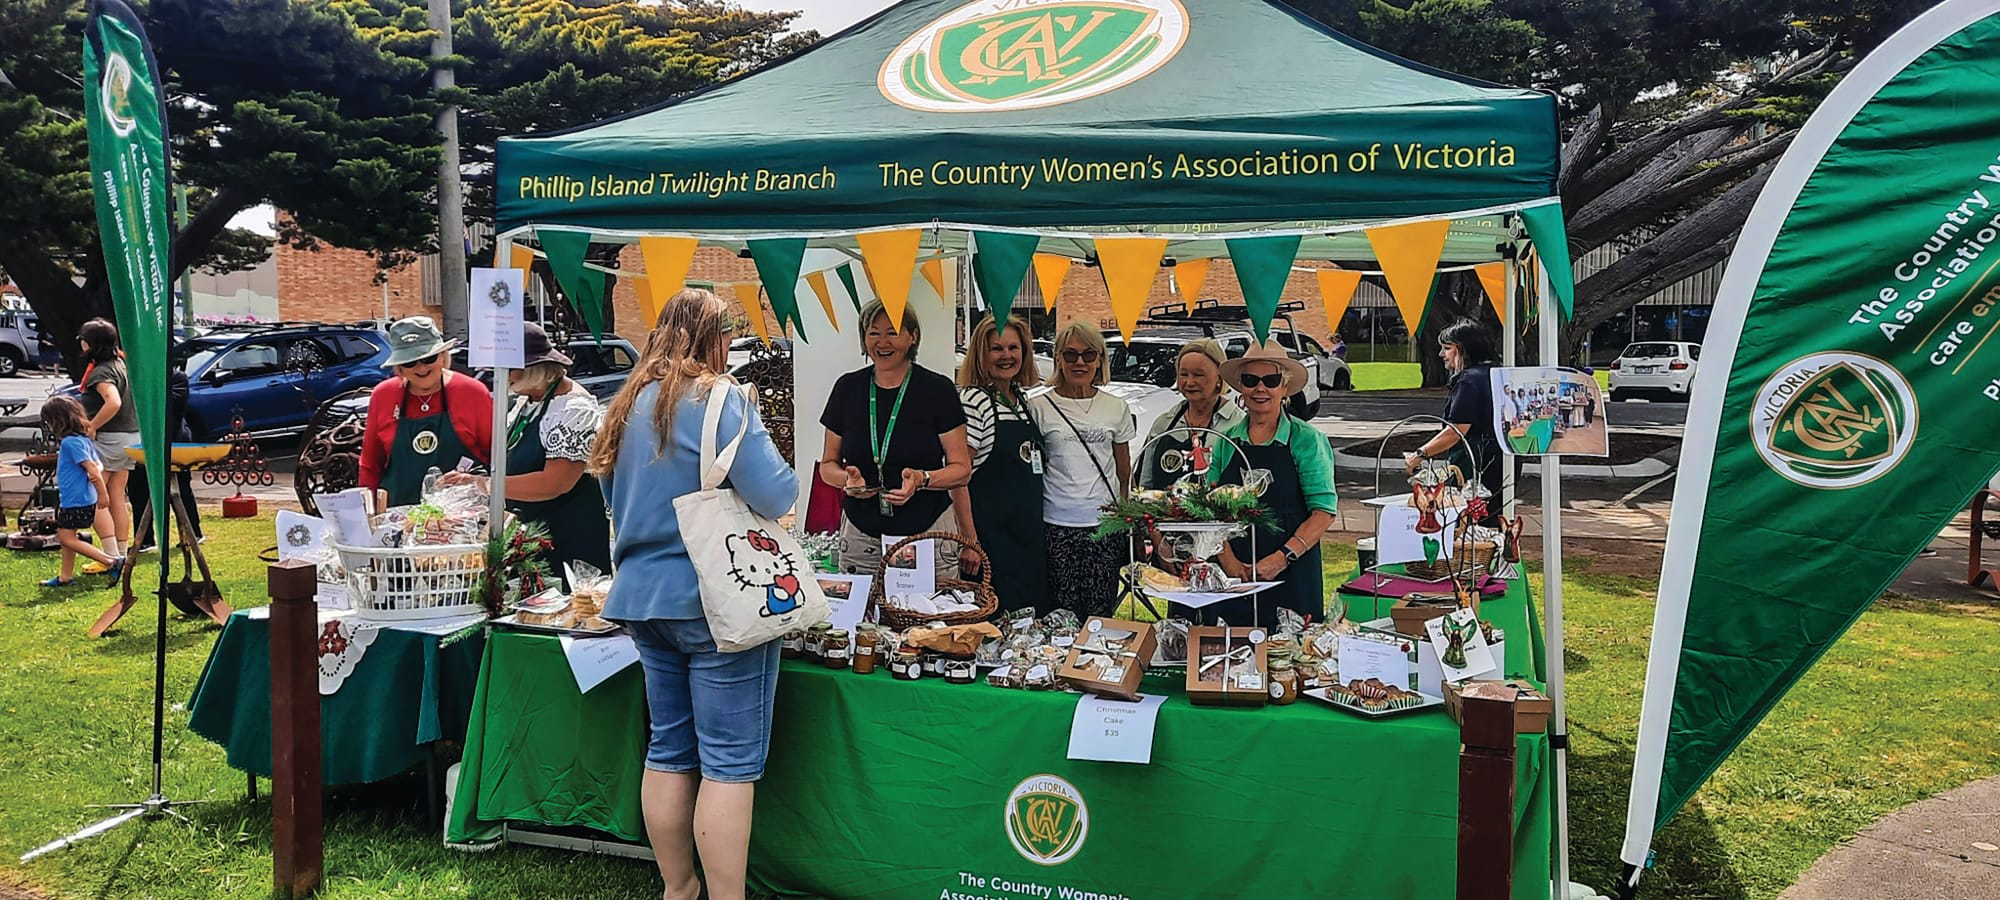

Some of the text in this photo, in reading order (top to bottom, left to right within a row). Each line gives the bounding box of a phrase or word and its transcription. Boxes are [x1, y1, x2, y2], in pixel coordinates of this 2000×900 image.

[519, 165, 837, 202] Phillip Island Twilight Branch
[878, 139, 1516, 191] The Country Women's Association of Victoria
[102, 170, 119, 208] Phillip
[114, 208, 128, 244] Island
[1847, 189, 1990, 325] The Country
[1929, 320, 1975, 366] care
[1763, 368, 1815, 422] VICTORIA
[1096, 705, 1137, 714] Christmas
[1103, 716, 1125, 724] Cake
[1104, 729, 1119, 737] $35
[1028, 781, 1067, 796] VICTORIA
[958, 872, 986, 889] The
[991, 877, 1053, 900] Country
